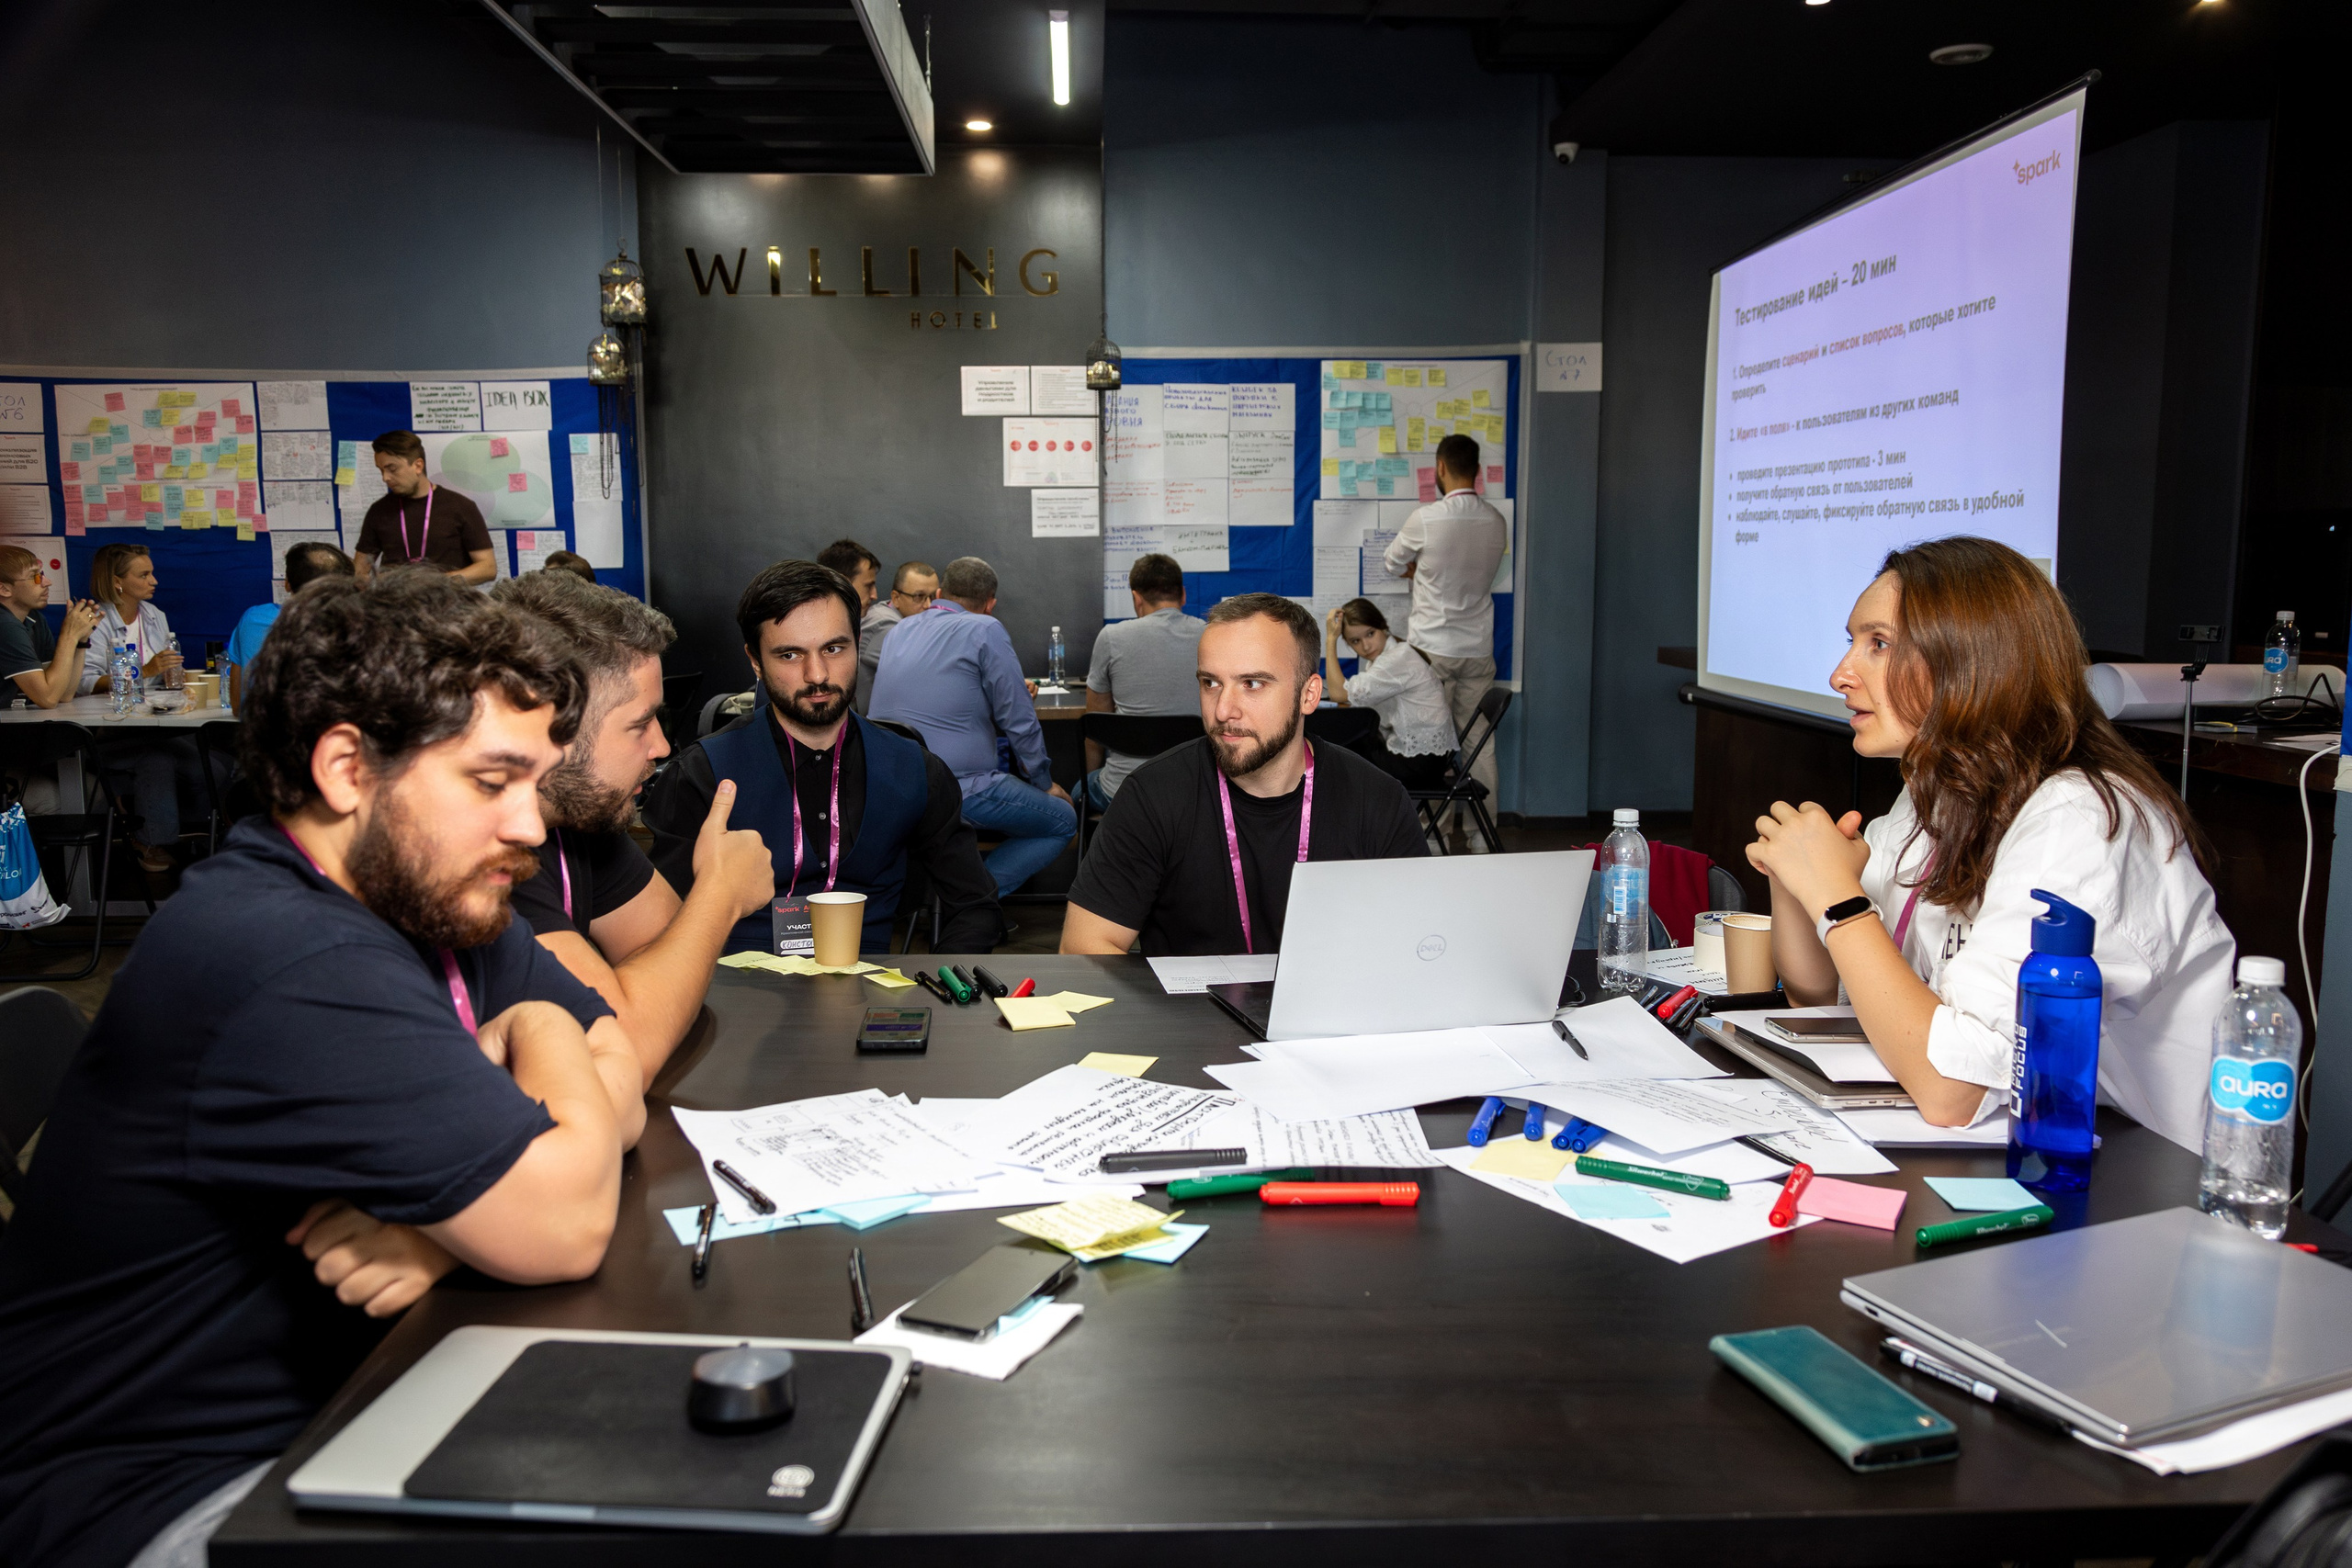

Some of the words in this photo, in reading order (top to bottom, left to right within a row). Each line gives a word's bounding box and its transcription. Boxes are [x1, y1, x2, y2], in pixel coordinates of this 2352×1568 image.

[2018, 149, 2061, 186] spark
[684, 245, 1059, 297] WILLING
[1735, 288, 1805, 326] Тестирование
[1808, 271, 1838, 303] идей
[1851, 260, 1867, 287] 20
[1870, 254, 1897, 279] мин
[910, 310, 999, 330] HOTEL
[1738, 357, 1781, 379] Определите
[1782, 344, 1819, 367] сценарий
[1822, 345, 1827, 356] и
[1829, 335, 1860, 355] список
[1862, 322, 1906, 345] вопросов,
[1909, 308, 1955, 333] которые
[1958, 296, 1996, 320] хотите
[484, 390, 518, 410] IDEA
[524, 389, 549, 407] BOX
[1732, 384, 1766, 403] проверить
[1736, 427, 1758, 442] Идите
[1796, 420, 1801, 431] к
[1803, 407, 1868, 430] пользователям
[1869, 404, 1880, 418] из
[1882, 398, 1915, 420] других
[1918, 389, 1959, 409] команд
[1737, 467, 1773, 483] проведите
[1774, 461, 1826, 479] презентацию
[1827, 456, 1871, 474] прототипа
[1877, 449, 1883, 467] 3
[1885, 450, 1906, 466] мин
[1736, 488, 1769, 504] получите
[1770, 485, 1805, 502] обратную
[1806, 483, 1831, 496] связь
[1833, 482, 1842, 494] от
[1844, 472, 1913, 494] пользователей
[1736, 507, 1781, 523] наблюдайте,
[1781, 504, 1821, 524] слушайте,
[1823, 502, 1874, 522] фиксируйте
[1877, 500, 1926, 519] обратную
[1928, 497, 1960, 513] связь
[1963, 499, 1969, 511] в
[1971, 489, 2025, 515] удобной
[1735, 529, 1759, 546] форме
[2014, 1024, 2028, 1090] FOCUS
